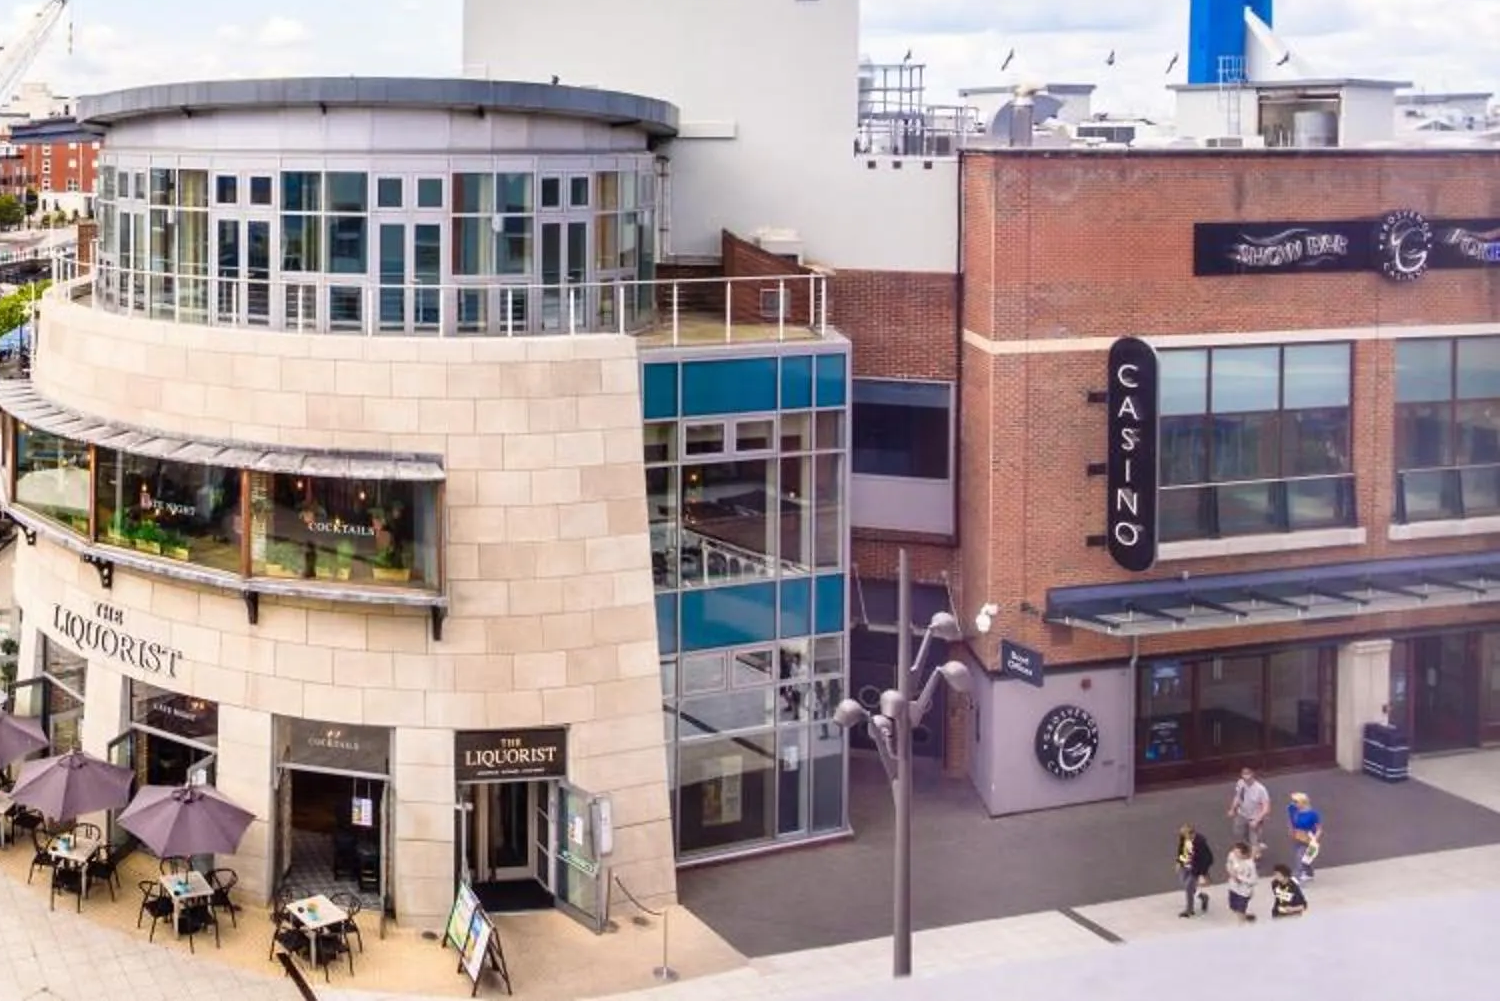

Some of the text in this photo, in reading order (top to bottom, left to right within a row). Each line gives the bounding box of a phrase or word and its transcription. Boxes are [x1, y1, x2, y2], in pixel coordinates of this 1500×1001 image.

[1114, 364, 1140, 546] CASINO
[308, 521, 376, 536] COCKTAILS
[95, 601, 125, 626] THE
[52, 602, 184, 679] LIQUORIST
[500, 738, 521, 748] THE
[465, 746, 557, 768] LIQUORIST
